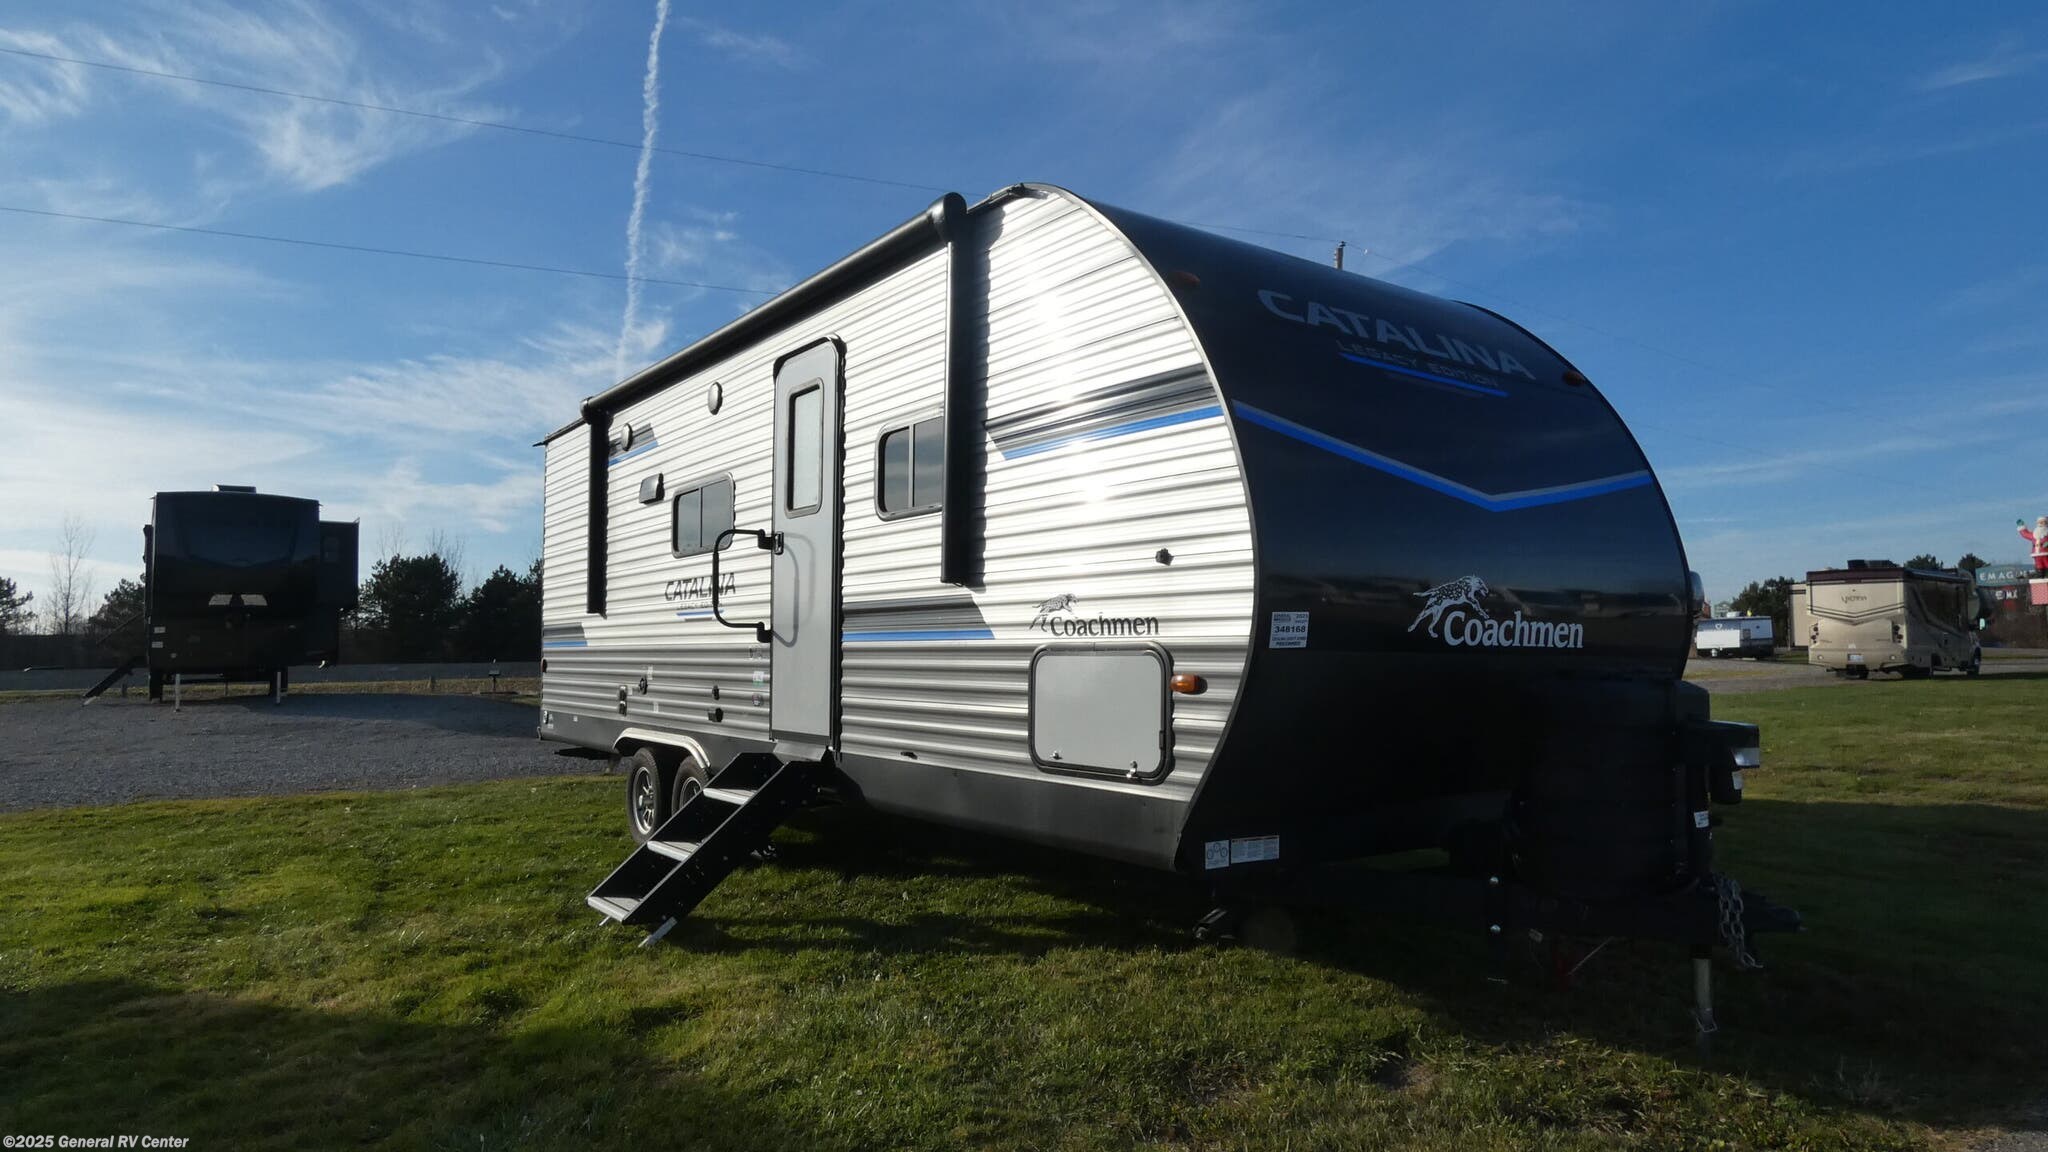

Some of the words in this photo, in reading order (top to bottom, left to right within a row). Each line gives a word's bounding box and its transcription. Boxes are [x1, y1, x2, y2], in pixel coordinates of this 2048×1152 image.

[1257, 289, 1536, 380] CATALINA
[664, 572, 736, 601] CATALINA
[1050, 612, 1159, 636] Coachmen
[1443, 610, 1584, 649] Coachmen
